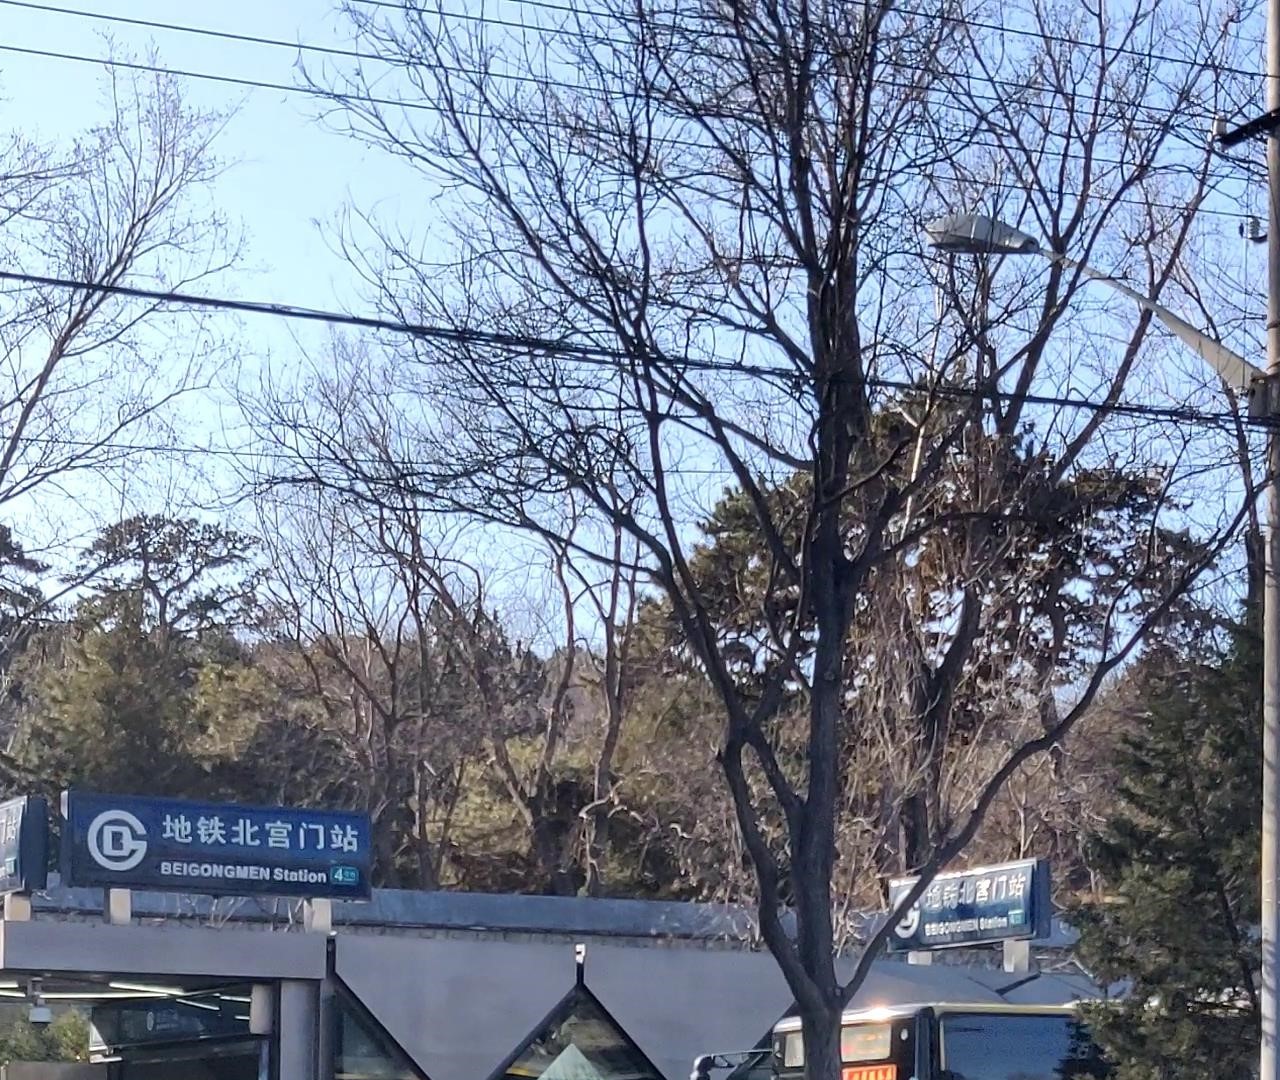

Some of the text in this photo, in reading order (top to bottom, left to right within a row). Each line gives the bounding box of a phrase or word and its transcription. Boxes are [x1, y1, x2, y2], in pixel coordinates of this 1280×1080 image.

[162, 814, 359, 852] 地铁北宫门站
[160, 862, 270, 881] BEIGONGMEN
[272, 868, 327, 883] Station
